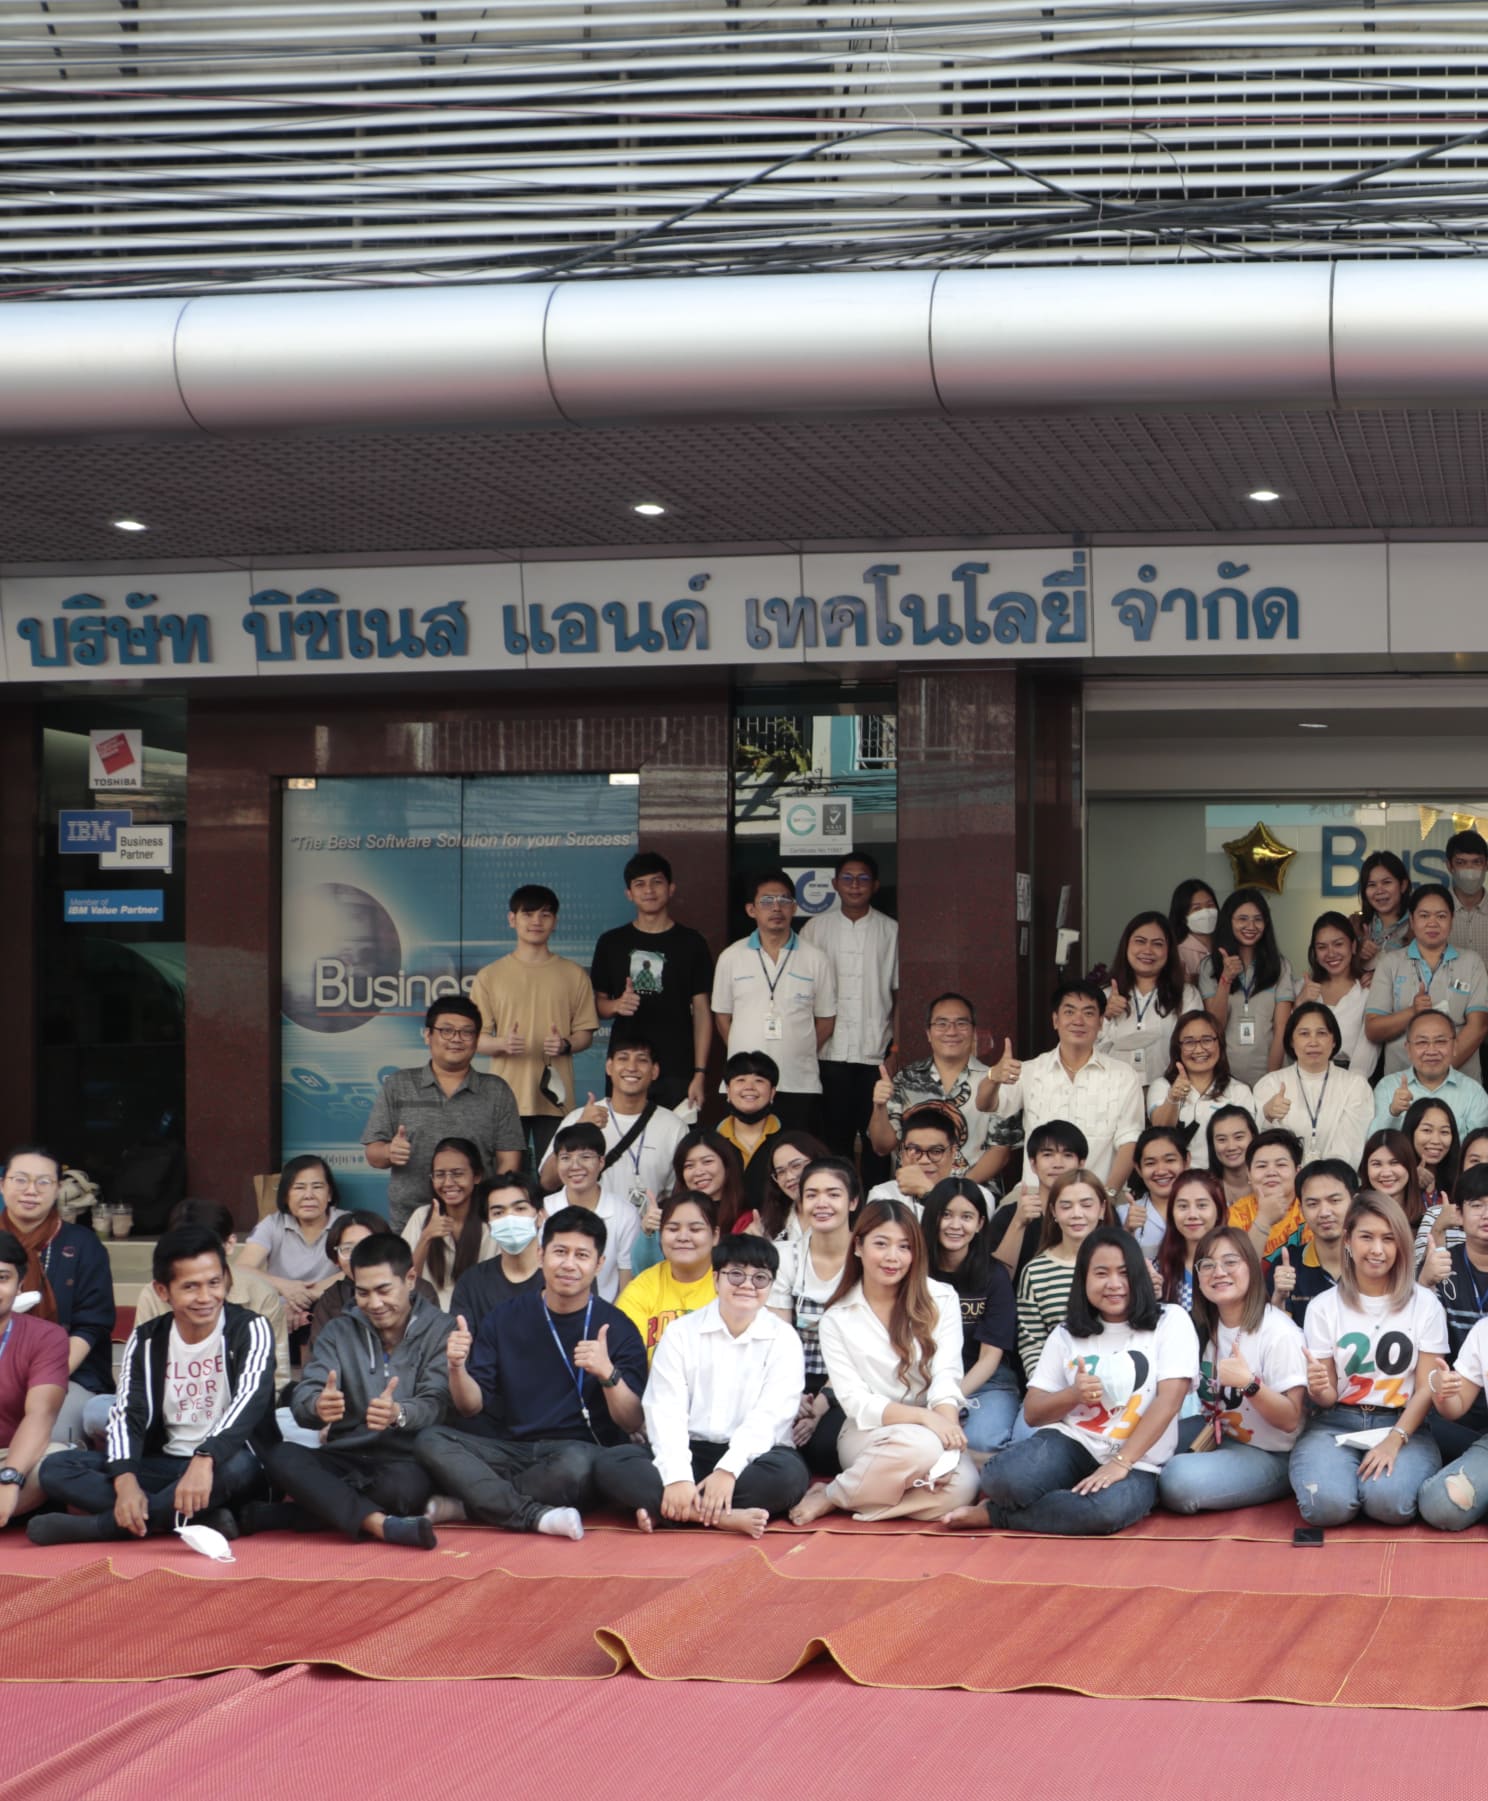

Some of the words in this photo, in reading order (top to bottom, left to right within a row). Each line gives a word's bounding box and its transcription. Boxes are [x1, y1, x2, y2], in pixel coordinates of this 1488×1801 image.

[16, 592, 213, 667] บริษัท
[502, 573, 711, 655] แอนด์
[744, 551, 1087, 650] เทคโนโลยี่
[1110, 561, 1300, 642] จำกัด
[94, 778, 137, 787] TOSHIBA
[67, 821, 111, 841] IBM
[120, 836, 163, 847] Business
[328, 835, 362, 849] Best
[365, 834, 432, 849] Software
[436, 832, 497, 848] Solution
[502, 832, 522, 848] for
[527, 834, 561, 850] your
[120, 849, 154, 860] Partner
[101, 898, 109, 906] of
[68, 906, 88, 915] IBM
[91, 906, 118, 915] Value
[120, 905, 159, 915] Partner
[1337, 1331, 1413, 1377] 20
